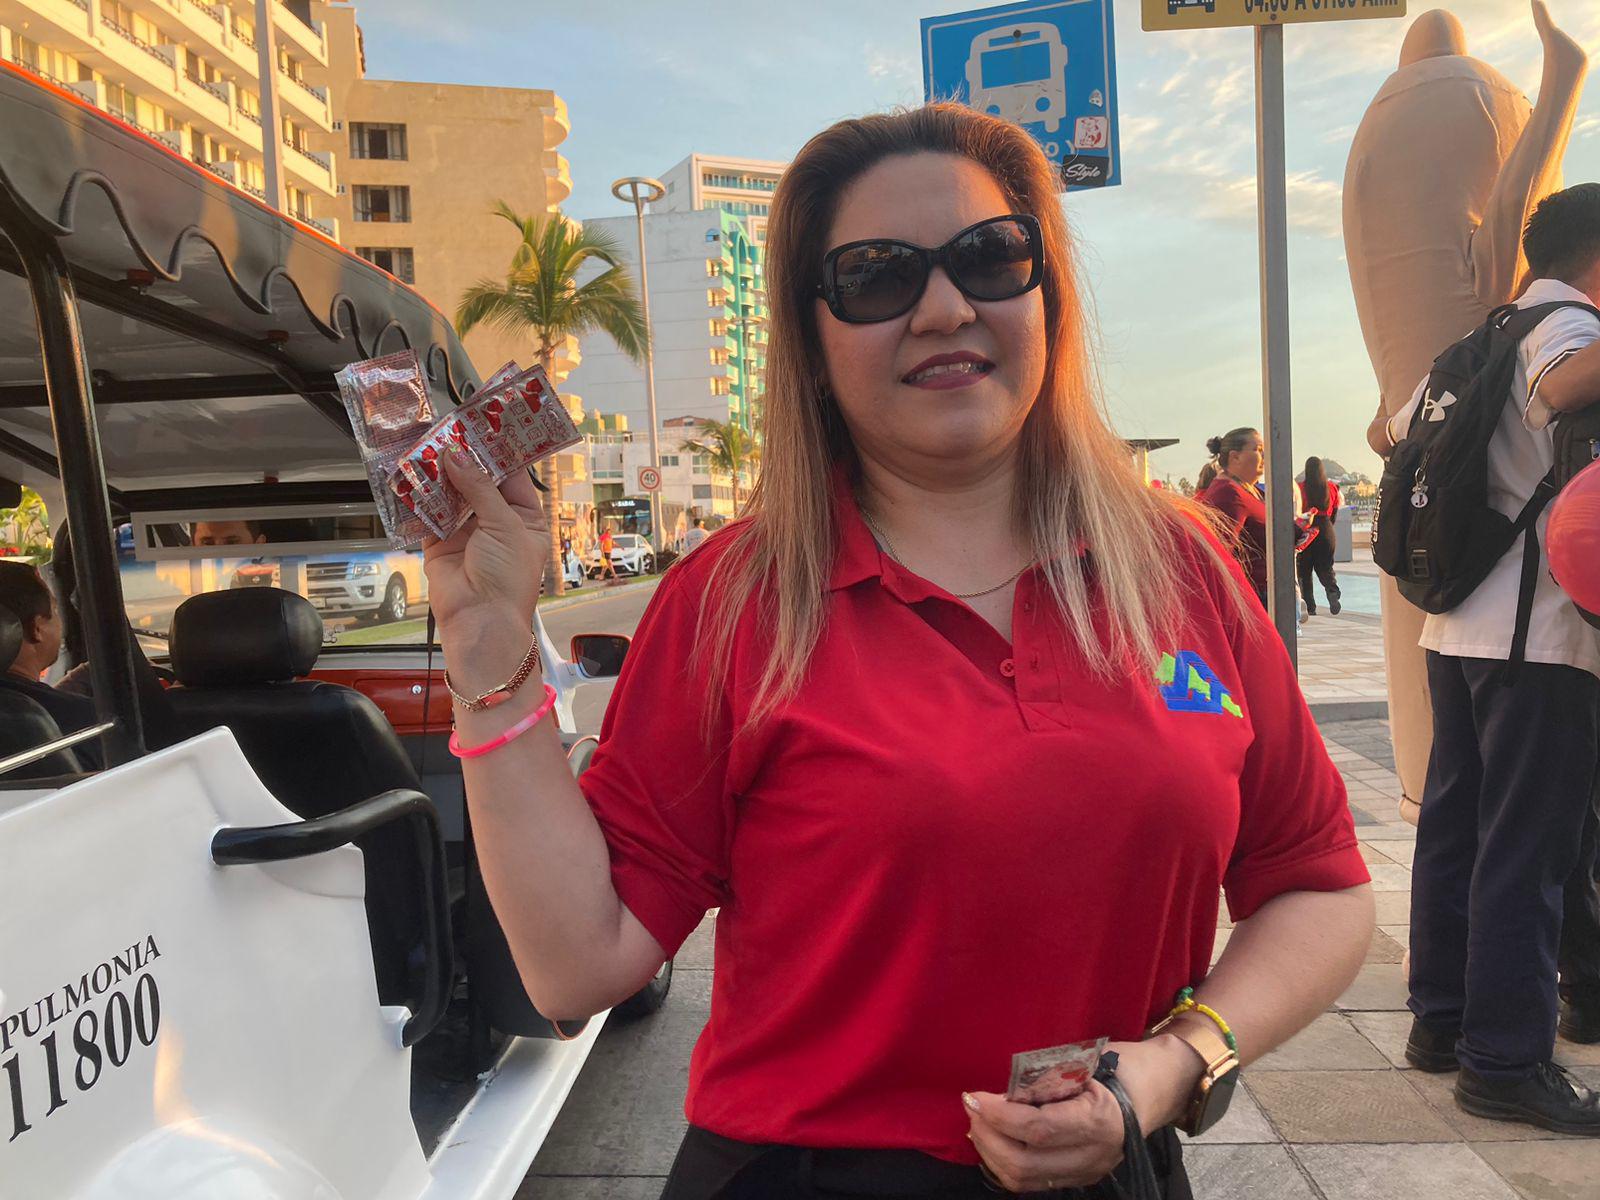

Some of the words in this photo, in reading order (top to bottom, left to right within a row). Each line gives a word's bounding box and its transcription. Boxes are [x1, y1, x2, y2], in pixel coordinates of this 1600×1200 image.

[1065, 163, 1101, 181] Style
[644, 472, 656, 483] 40
[0, 934, 162, 1054] PULMONIA
[2, 973, 161, 1143] 11800
